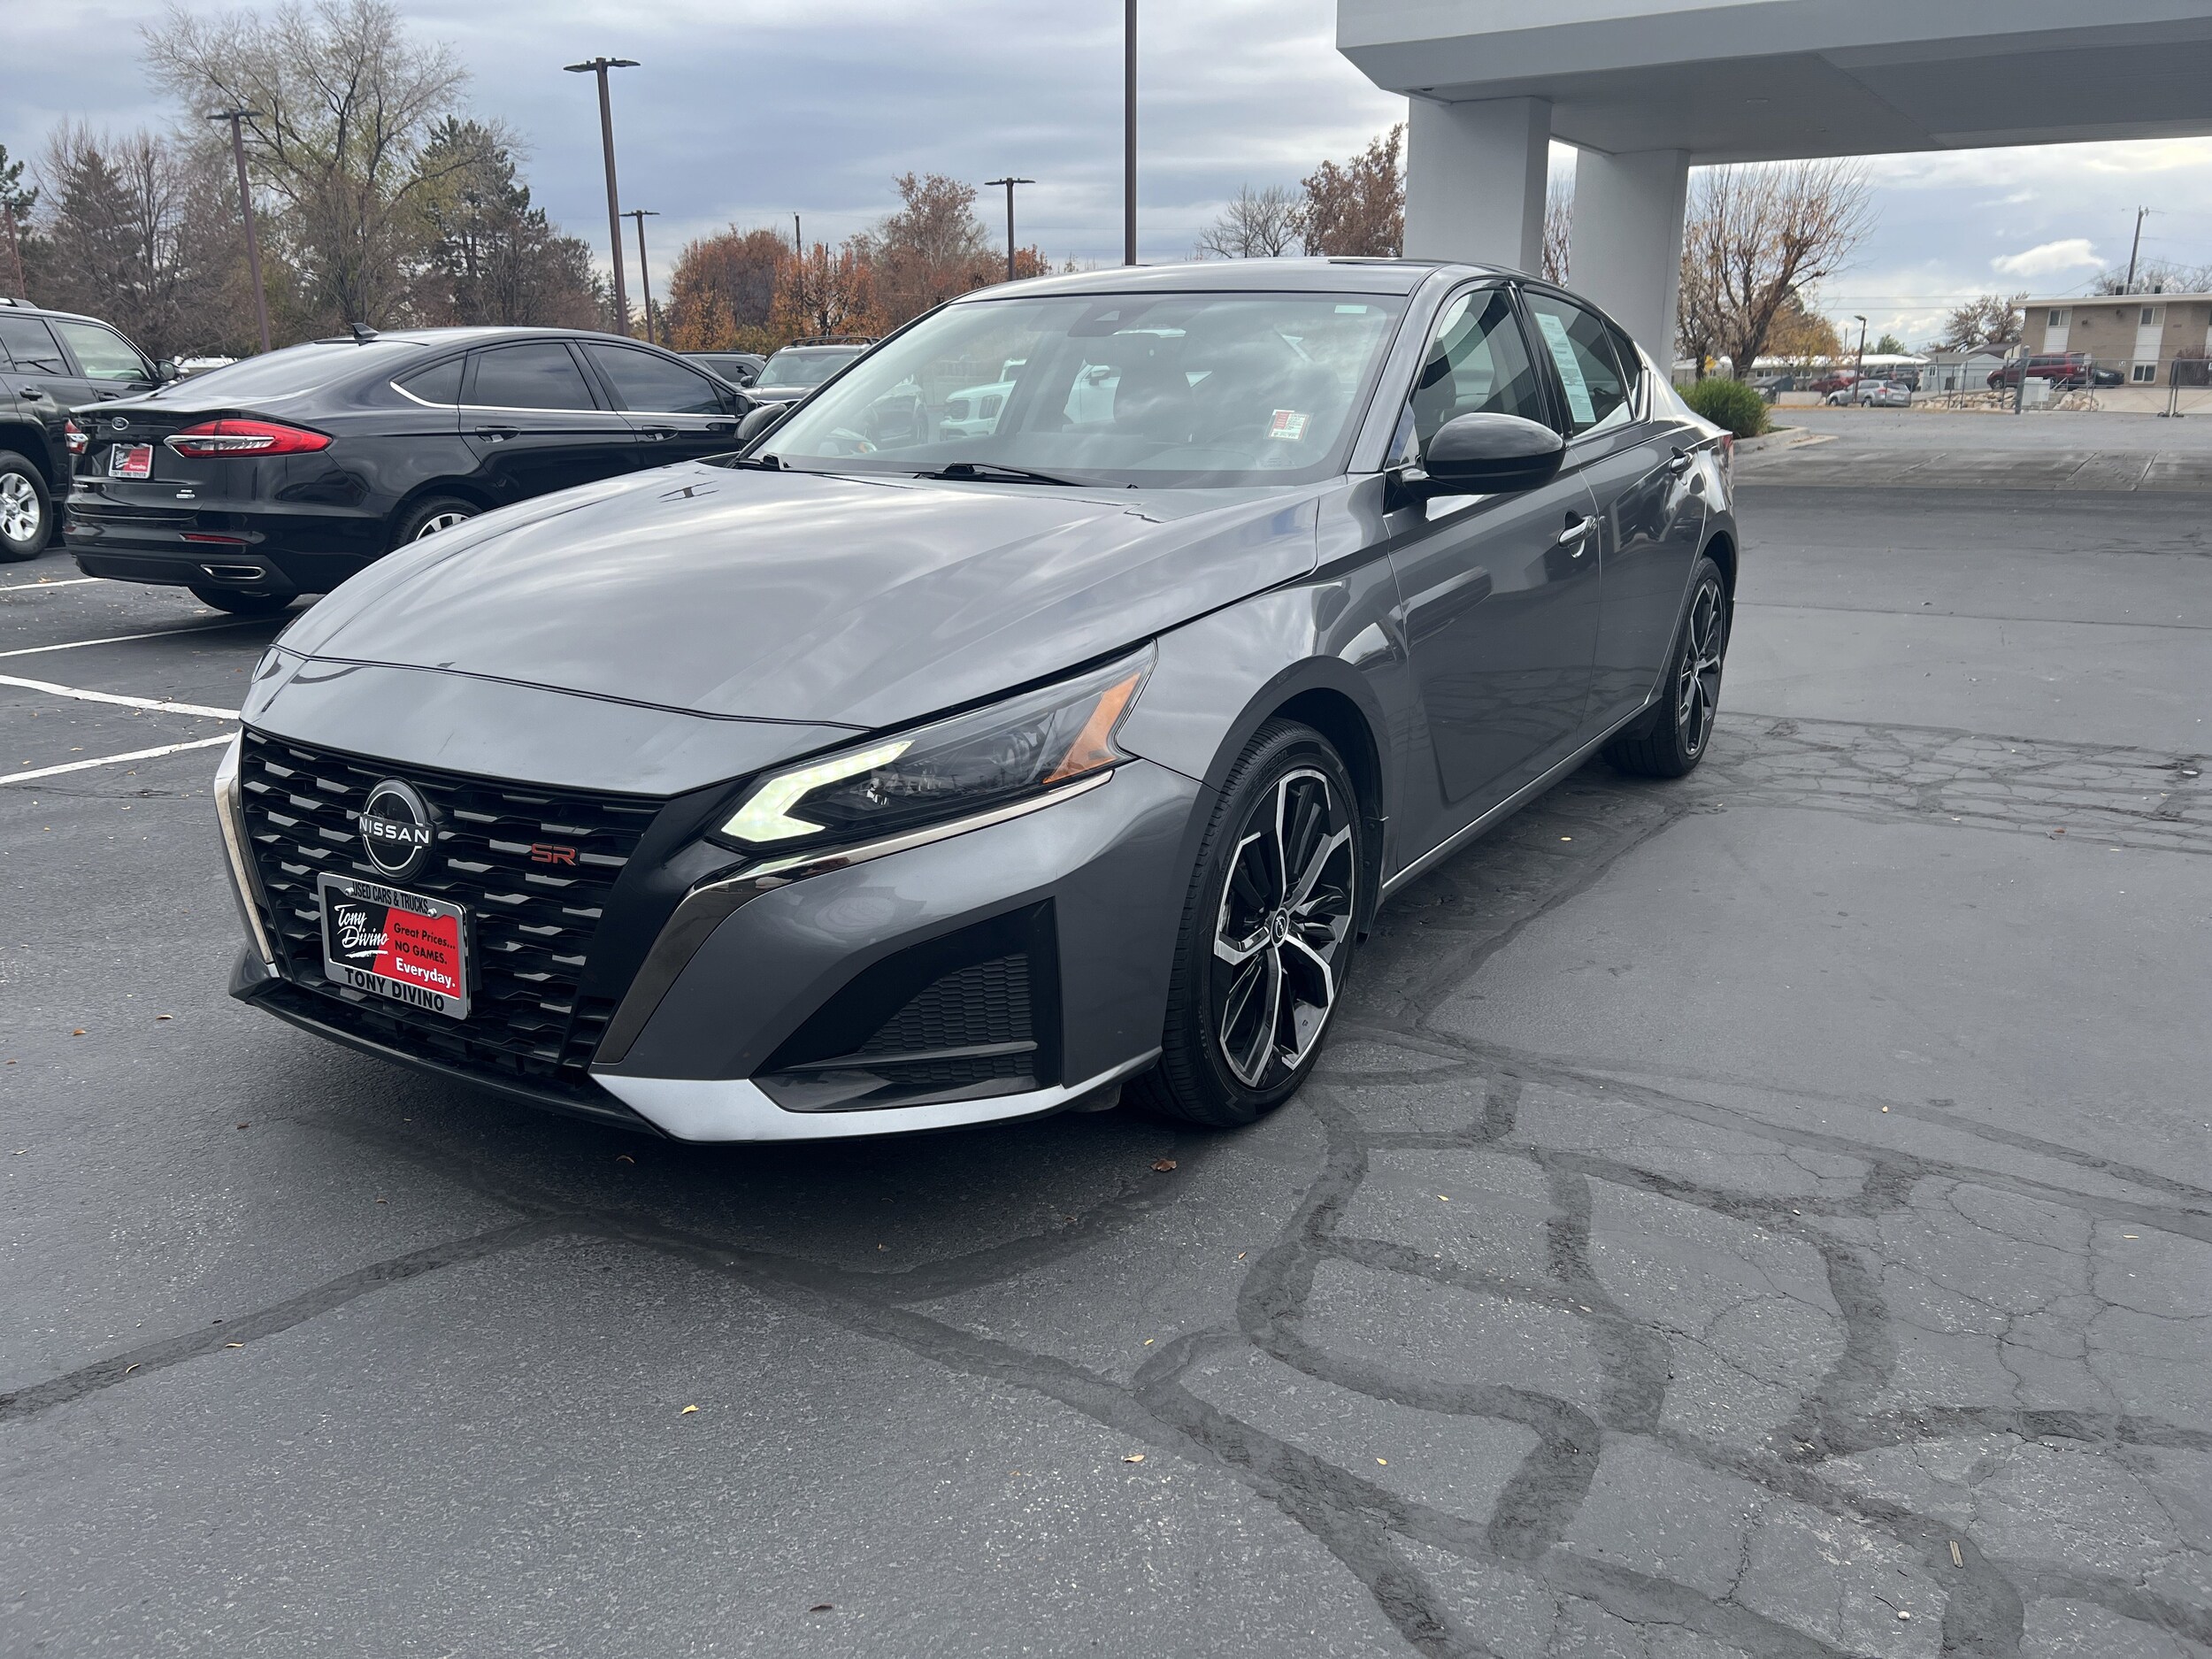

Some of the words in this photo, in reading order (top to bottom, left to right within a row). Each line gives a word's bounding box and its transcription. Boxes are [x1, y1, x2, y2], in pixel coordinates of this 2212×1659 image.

[359, 818, 429, 844] NISSAN
[532, 842, 577, 866] SR
[352, 881, 372, 899] USED
[373, 885, 391, 905] CARS
[393, 891, 400, 907] &
[400, 893, 429, 915] TRUCKS
[334, 903, 367, 933] Tony
[337, 926, 389, 949] Divino
[394, 923, 419, 939] Great
[421, 930, 456, 949] Prices...
[395, 940, 411, 954] NO
[412, 945, 448, 964] GAMES.
[396, 956, 456, 988] Everyday.
[345, 967, 386, 994] TONY
[392, 980, 445, 1011] DIVINO
